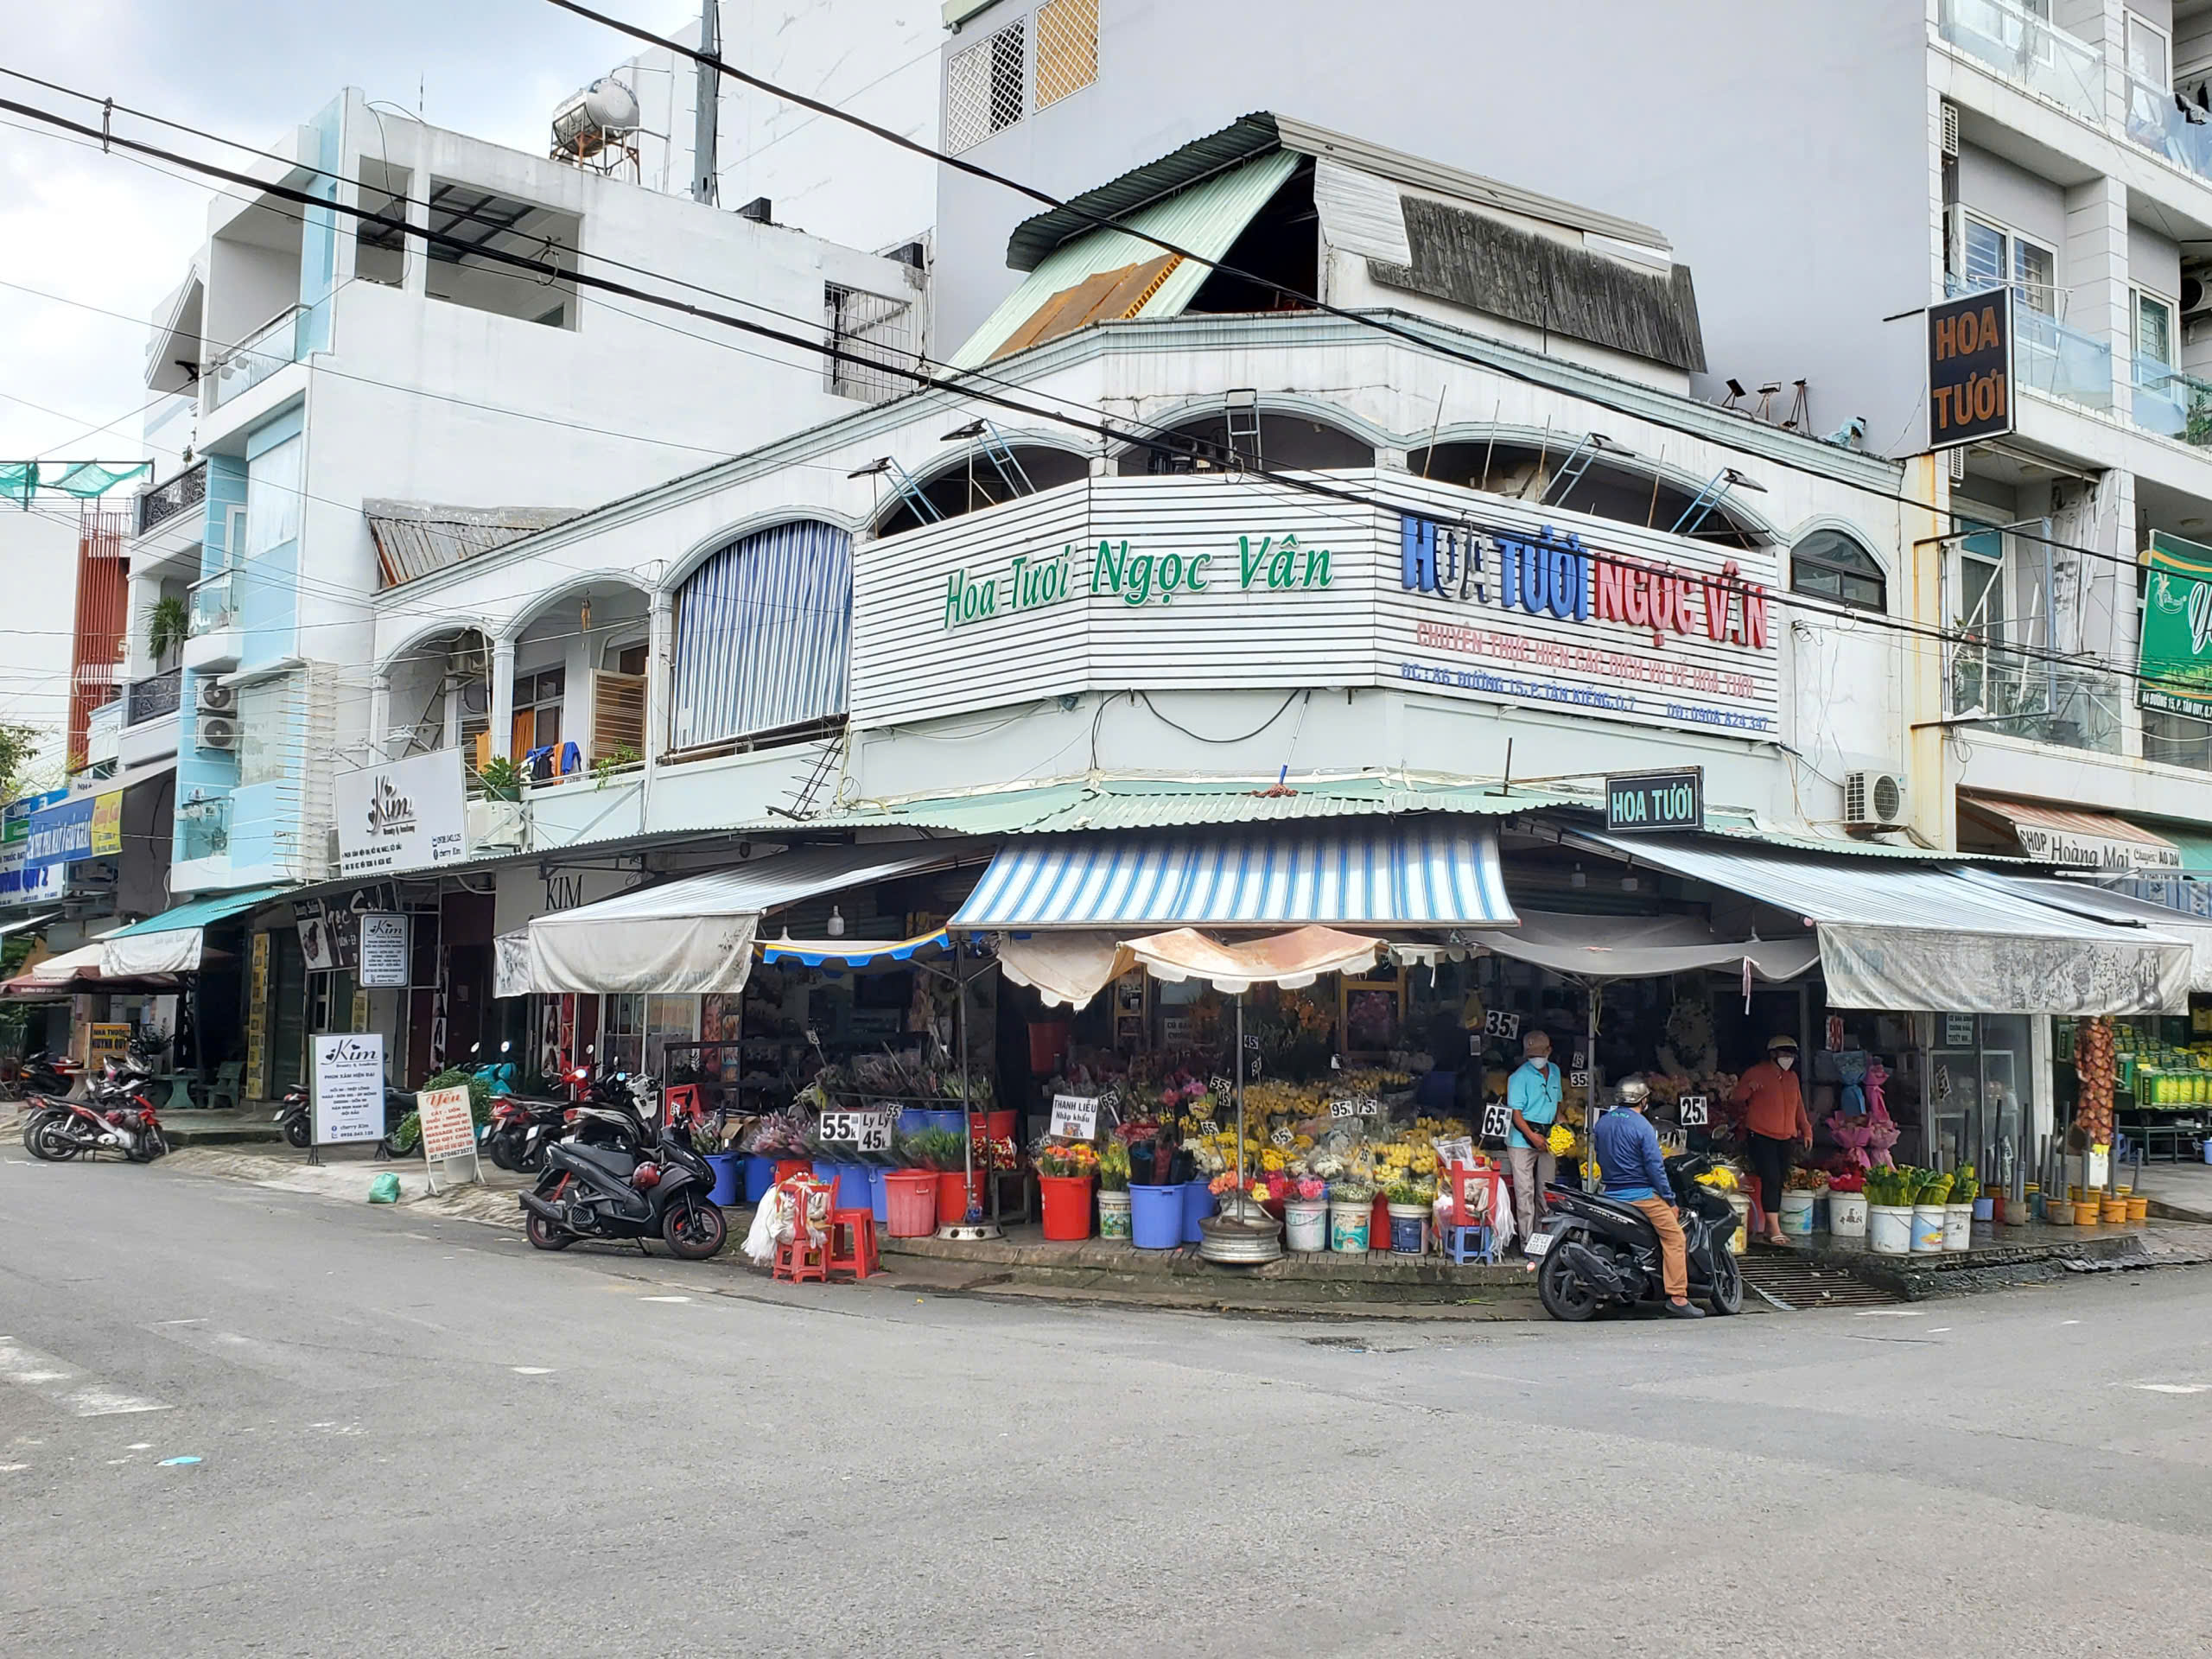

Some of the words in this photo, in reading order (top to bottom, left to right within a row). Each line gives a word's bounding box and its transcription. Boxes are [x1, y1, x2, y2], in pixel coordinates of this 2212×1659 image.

[1936, 306, 1999, 360] HOA
[1933, 368, 2005, 429] TƯƠI
[944, 568, 999, 630] Hoa
[1011, 543, 1077, 610] Tươi
[1090, 538, 1213, 607] Ngọc
[1237, 533, 1334, 591] Vân
[1493, 524, 1588, 621] TƯƠI
[1594, 552, 1697, 647] NGỌC
[1417, 621, 1483, 655] CHUYÊN
[1694, 668, 1720, 694] HOA
[1612, 790, 1647, 823] HOA
[1651, 782, 1693, 821] TƯƠI
[2020, 830, 2047, 853] SHOP
[545, 874, 583, 910] KIM
[321, 1039, 378, 1065] Kim
[862, 1113, 874, 1128] Ly
[1054, 1099, 1077, 1111] THANH
[822, 1114, 856, 1140] 55k
